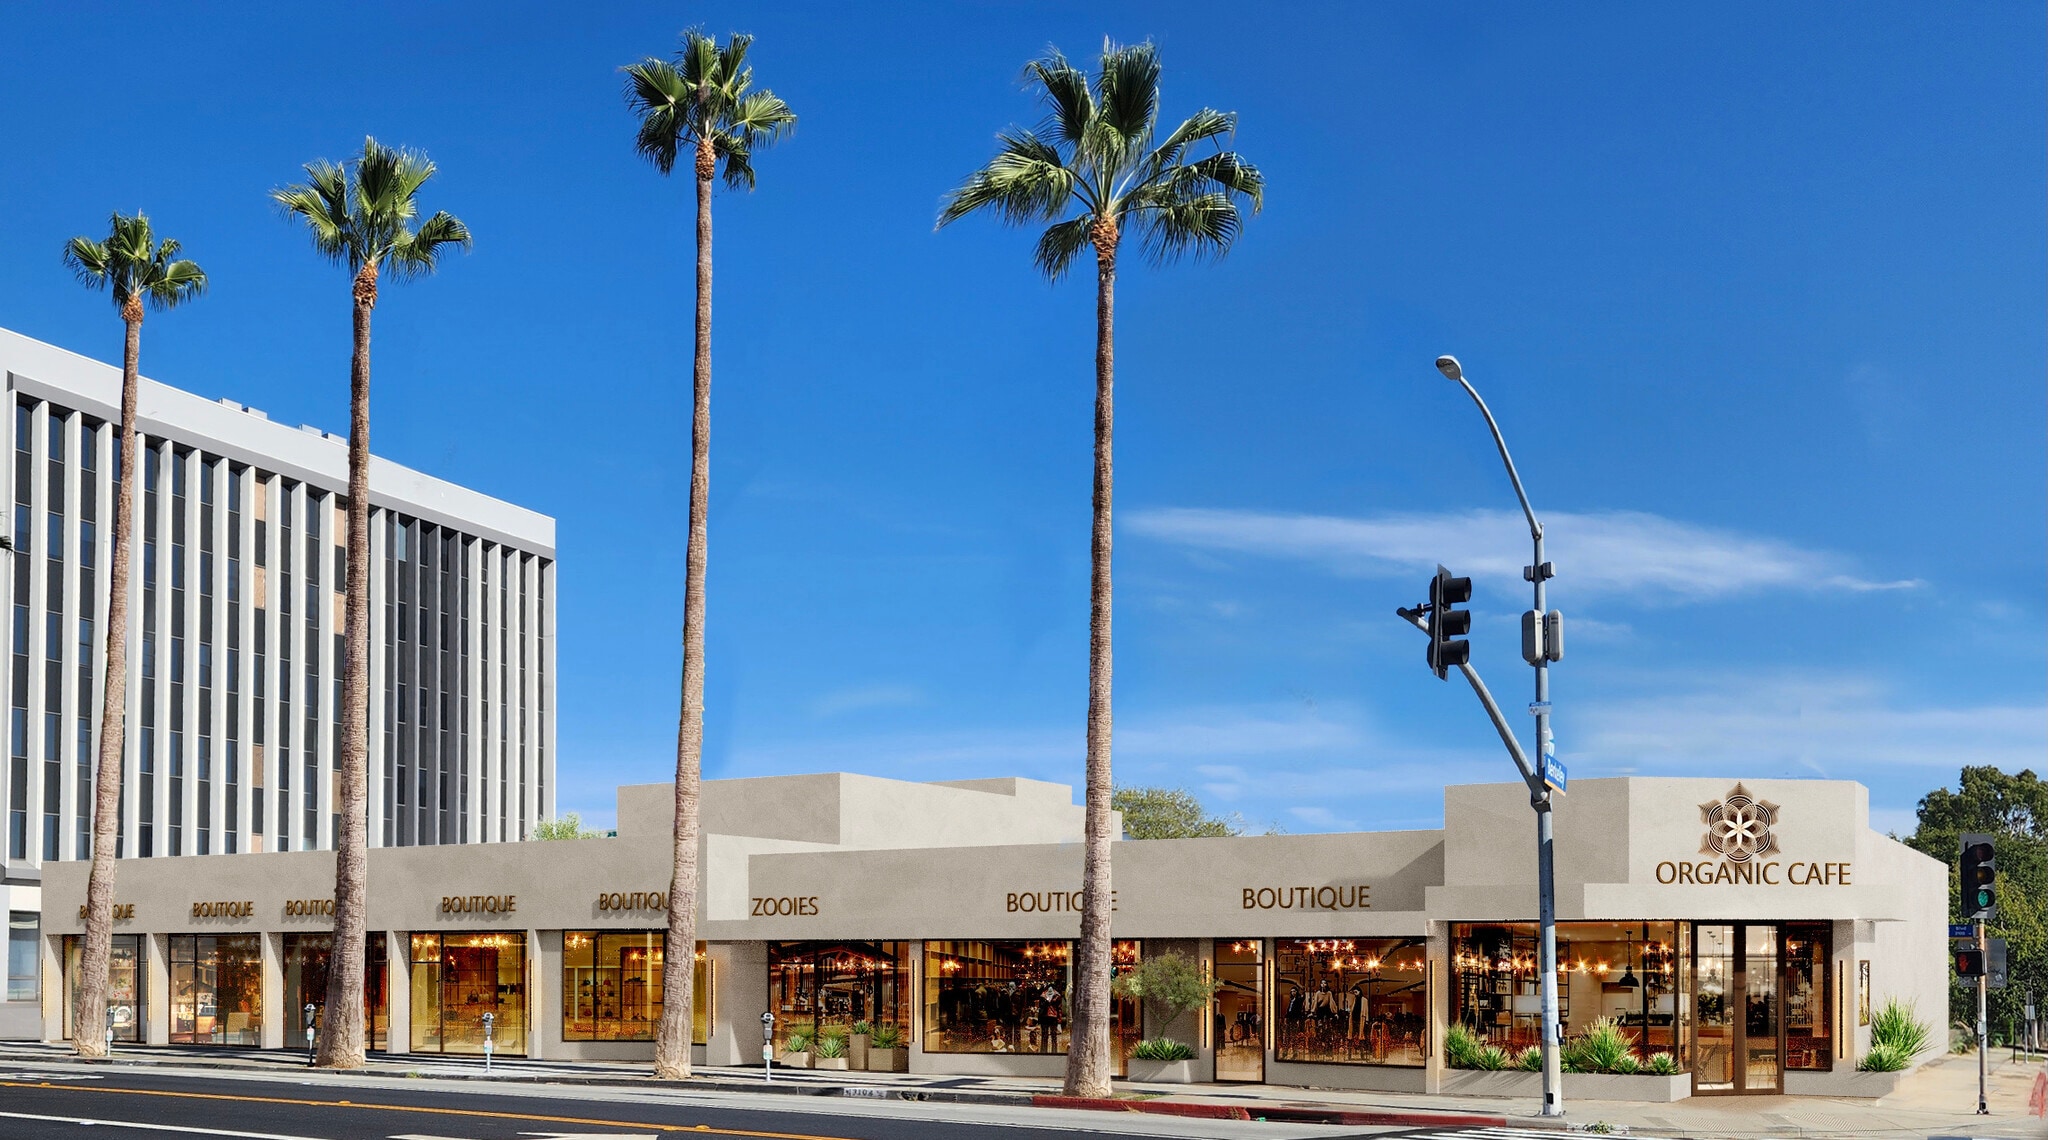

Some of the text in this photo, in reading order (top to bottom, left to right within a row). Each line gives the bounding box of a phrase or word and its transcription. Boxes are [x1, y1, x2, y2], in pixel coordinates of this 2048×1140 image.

[1655, 861, 1851, 885] ORGANIC CAFE
[286, 899, 335, 916] BOUTIQ
[442, 895, 517, 914] BOUTIQUE
[599, 891, 669, 911] BOUTIQU
[752, 897, 819, 916] ZOOIES
[1243, 886, 1371, 911] BOUTIQUE
[192, 901, 254, 918] BOUTIQUE
